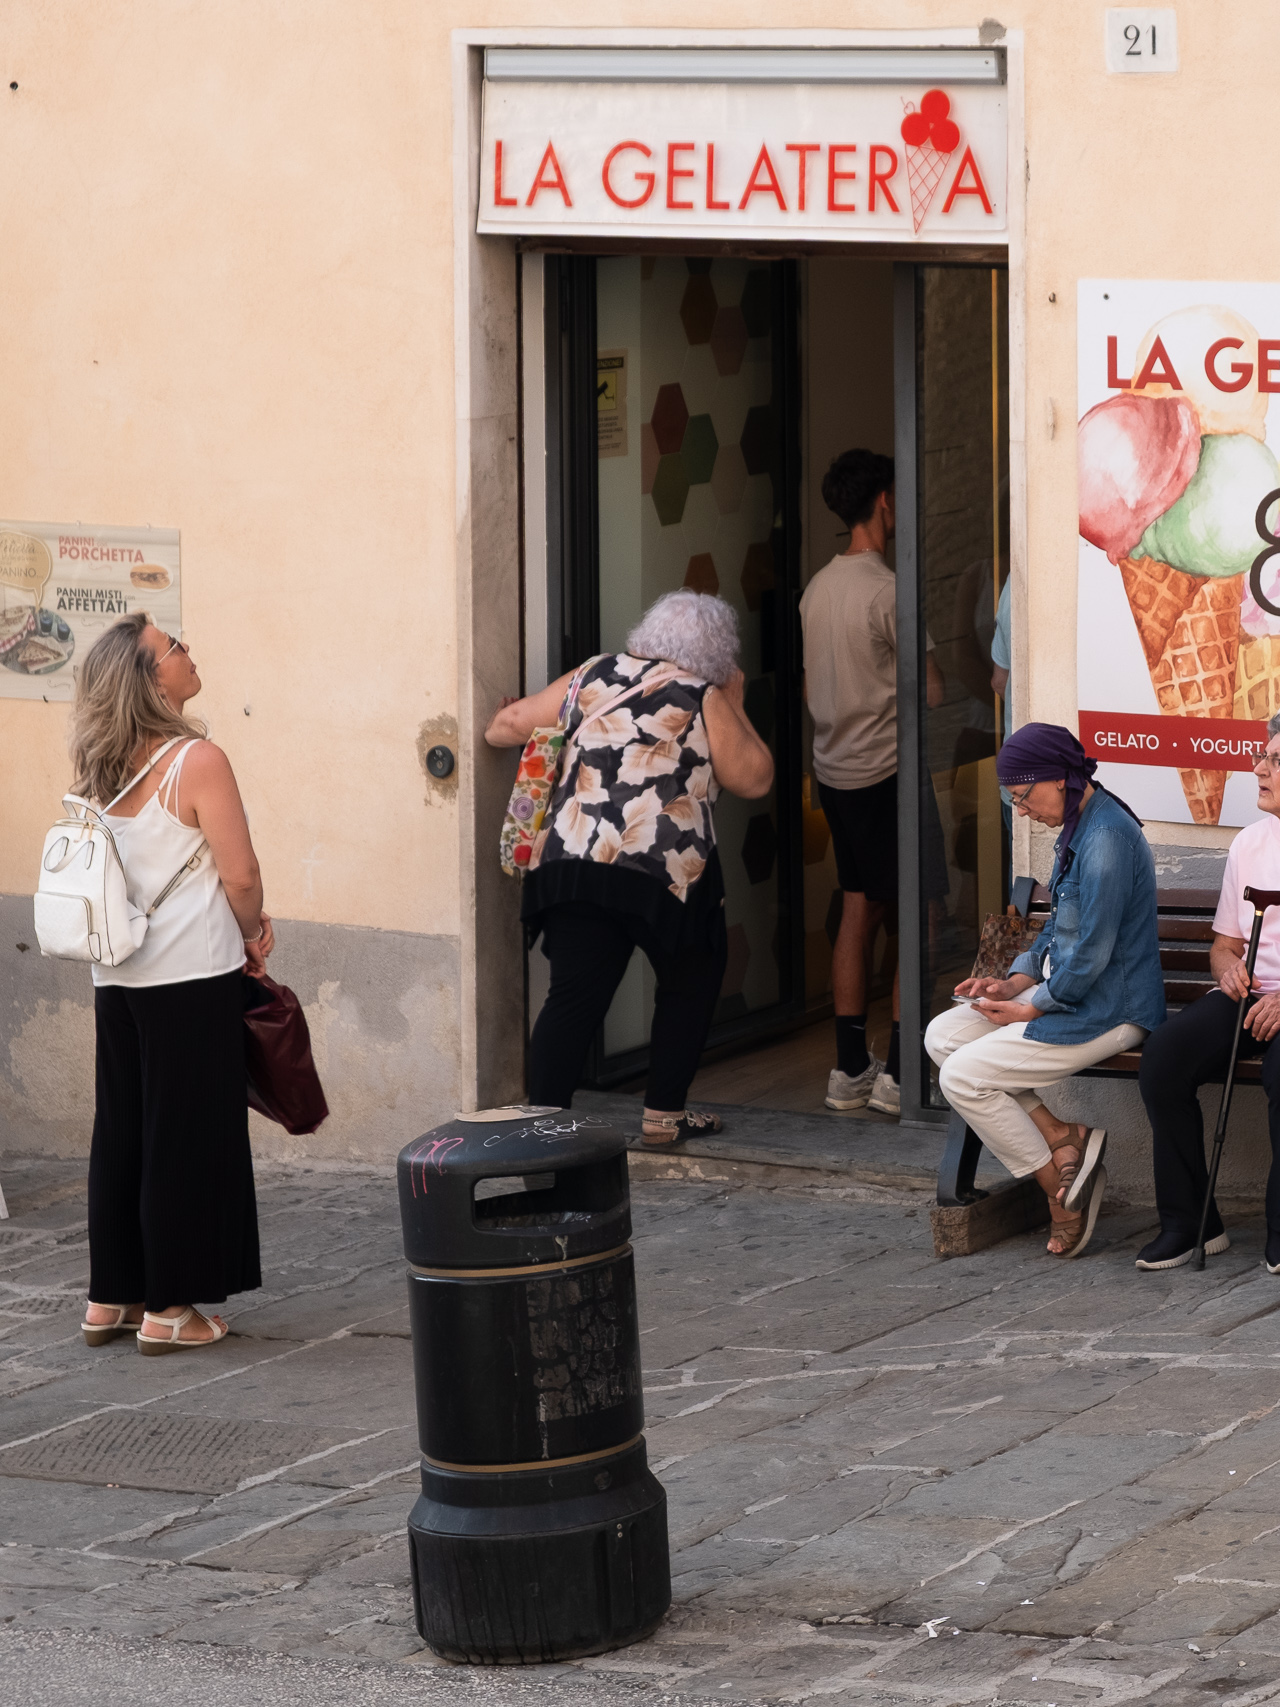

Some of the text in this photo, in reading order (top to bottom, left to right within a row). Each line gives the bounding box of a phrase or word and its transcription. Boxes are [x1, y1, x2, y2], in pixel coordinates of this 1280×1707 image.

[1123, 24, 1158, 56] 21
[494, 139, 574, 209] LA
[1106, 334, 1183, 391] LA
[58, 535, 95, 547] PANINI
[58, 546, 145, 563] PORCHETTA
[56, 587, 92, 599] PANINI
[95, 589, 122, 600] MISTI
[56, 597, 128, 614] AFFETTATI
[1094, 731, 1160, 750] GELATO
[1190, 736, 1264, 756] YOGURT
